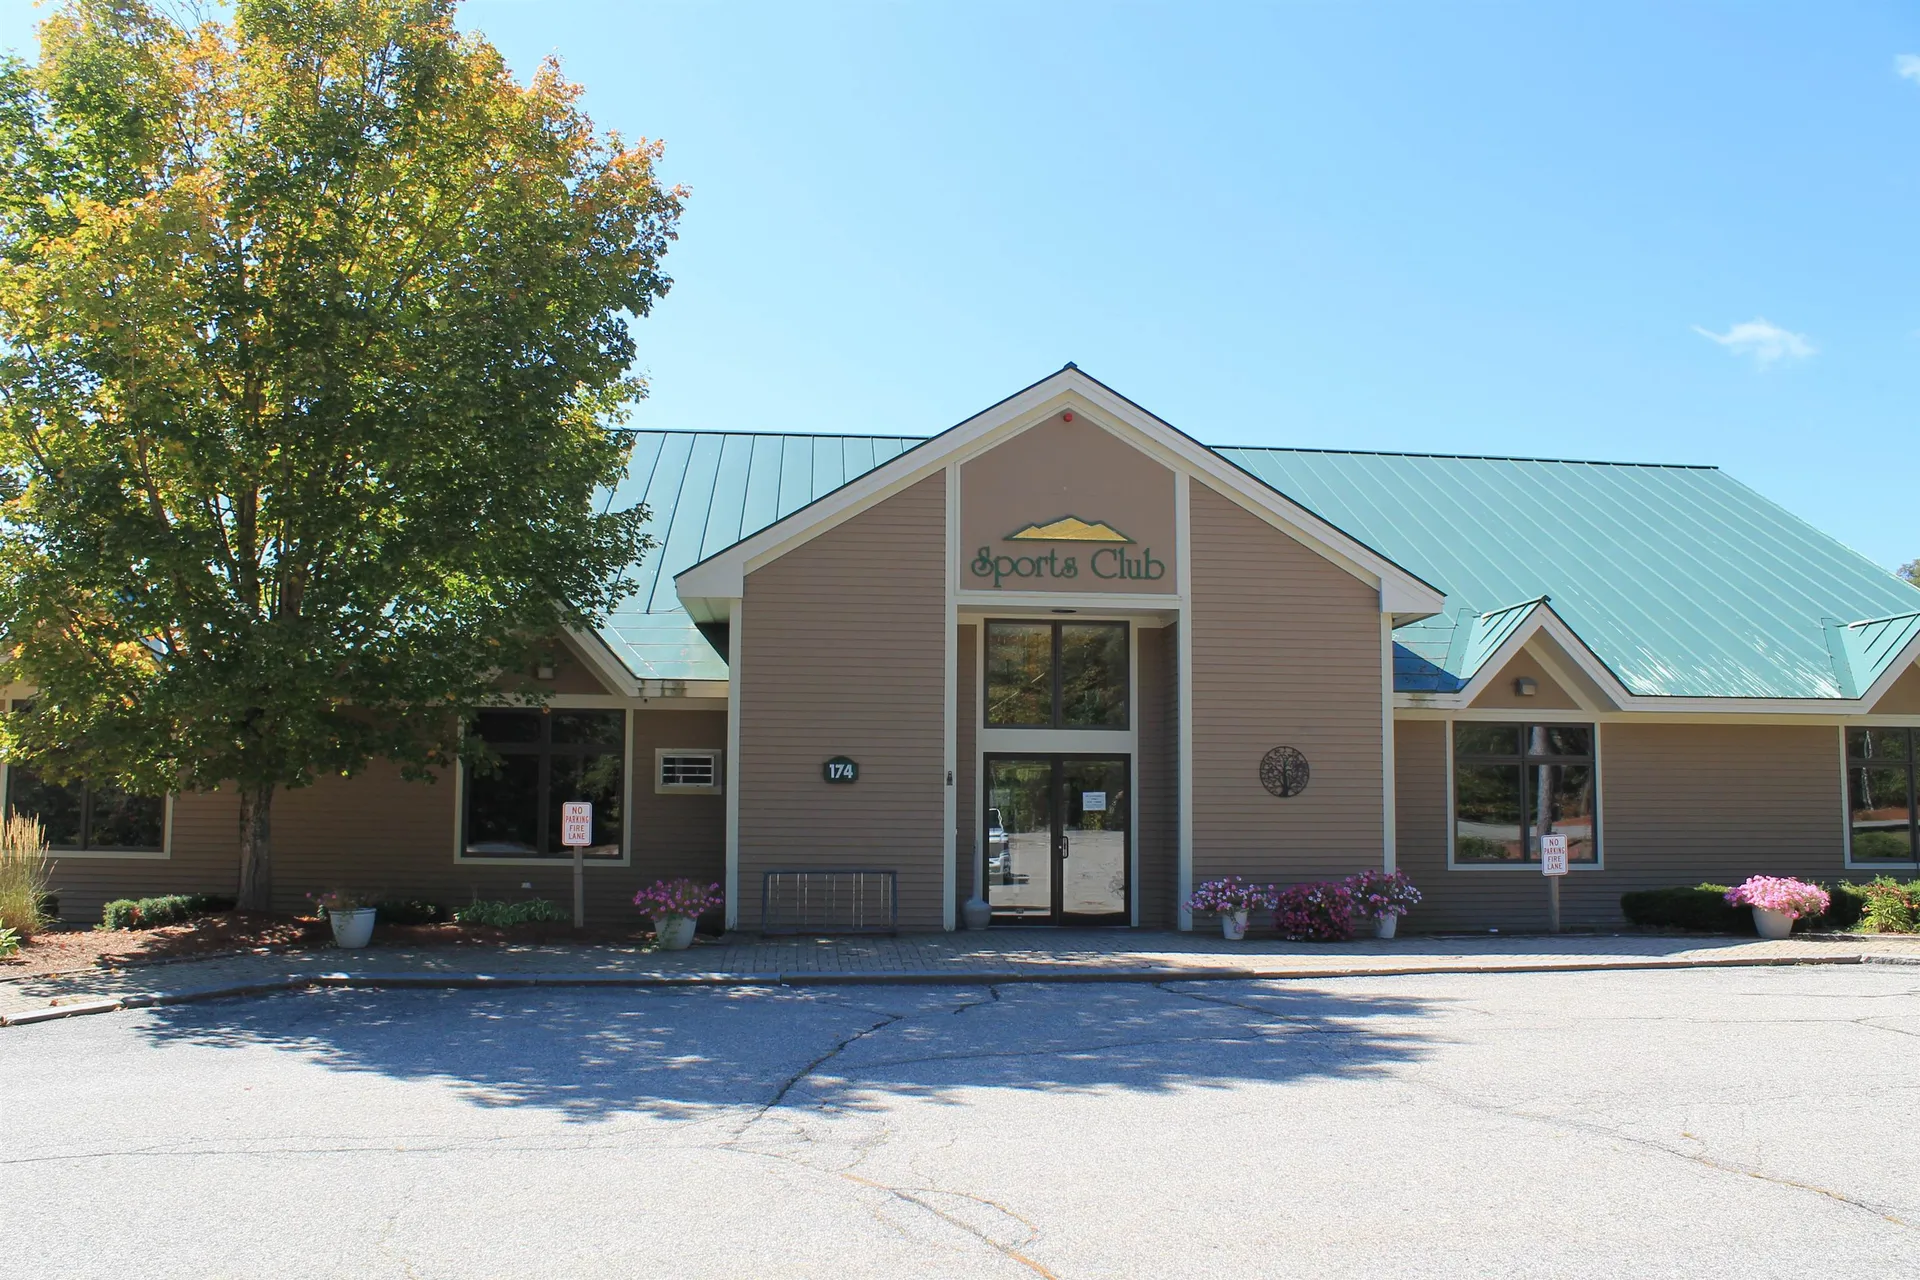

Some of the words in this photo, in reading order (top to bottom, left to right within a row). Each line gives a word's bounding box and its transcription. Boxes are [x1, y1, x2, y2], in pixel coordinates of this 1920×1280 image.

[971, 546, 1078, 588] Sports
[1091, 547, 1165, 580] Club
[829, 764, 854, 779] 174
[572, 806, 583, 814] NO
[565, 815, 589, 824] PARKING
[1544, 847, 1565, 855] PARKING
